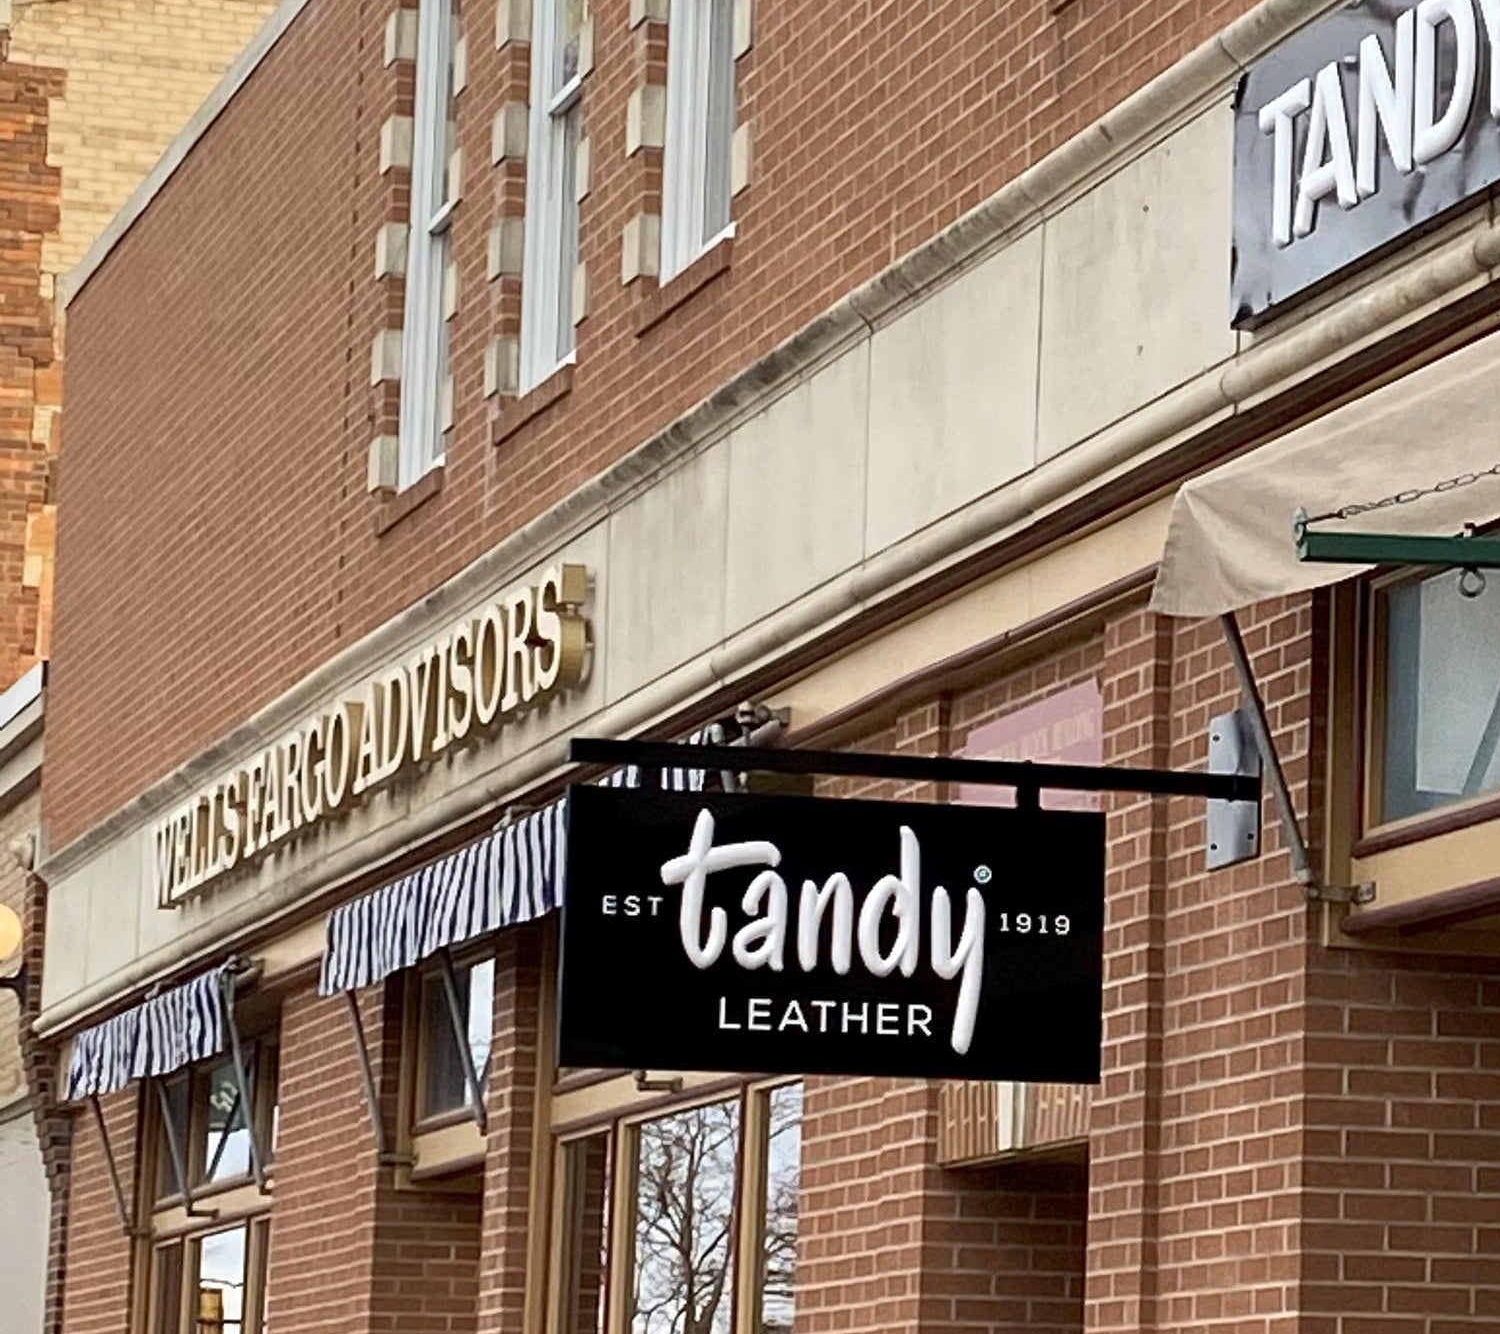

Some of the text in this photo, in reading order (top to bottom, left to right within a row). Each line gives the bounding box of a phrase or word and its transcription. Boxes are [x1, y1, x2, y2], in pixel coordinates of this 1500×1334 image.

[154, 564, 567, 910] WELLS FARGO ADVISORS
[601, 807, 1071, 1055] EST tandy 1919
[718, 996, 933, 1036] LEATHER
